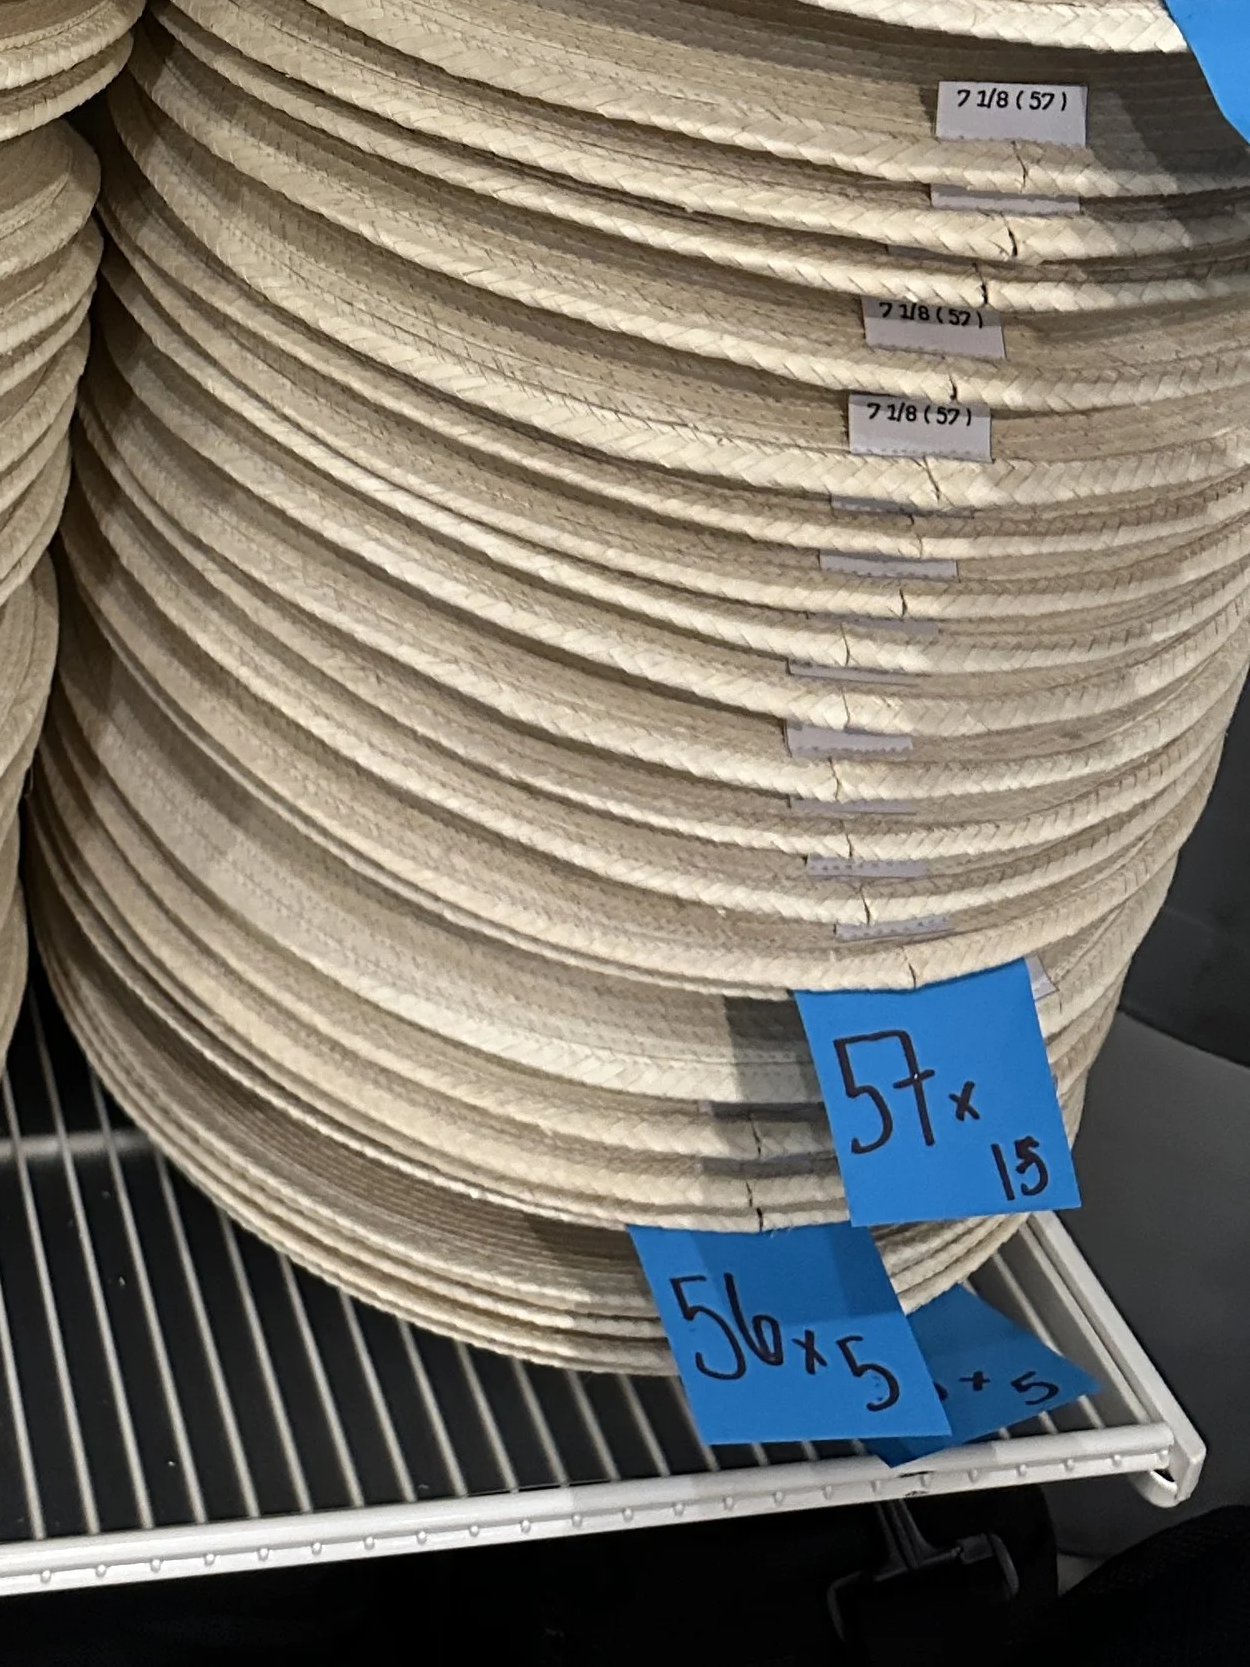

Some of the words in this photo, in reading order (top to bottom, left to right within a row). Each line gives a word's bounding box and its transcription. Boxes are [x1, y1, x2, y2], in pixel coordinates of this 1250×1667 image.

[956, 89, 971, 107] 7
[976, 88, 1009, 109] 1/8
[1015, 90, 1067, 111] (57)
[879, 302, 893, 318] 7
[898, 302, 930, 321] 1/8
[936, 306, 983, 329] (57)
[867, 402, 881, 419] 7
[887, 402, 917, 422] 1/8
[924, 405, 972, 426] (57)
[833, 1028, 935, 1155] 57
[991, 1136, 1049, 1201] 15
[668, 1272, 783, 1381] 56
[836, 1335, 900, 1412] 5
[1010, 1370, 1060, 1406] 5
